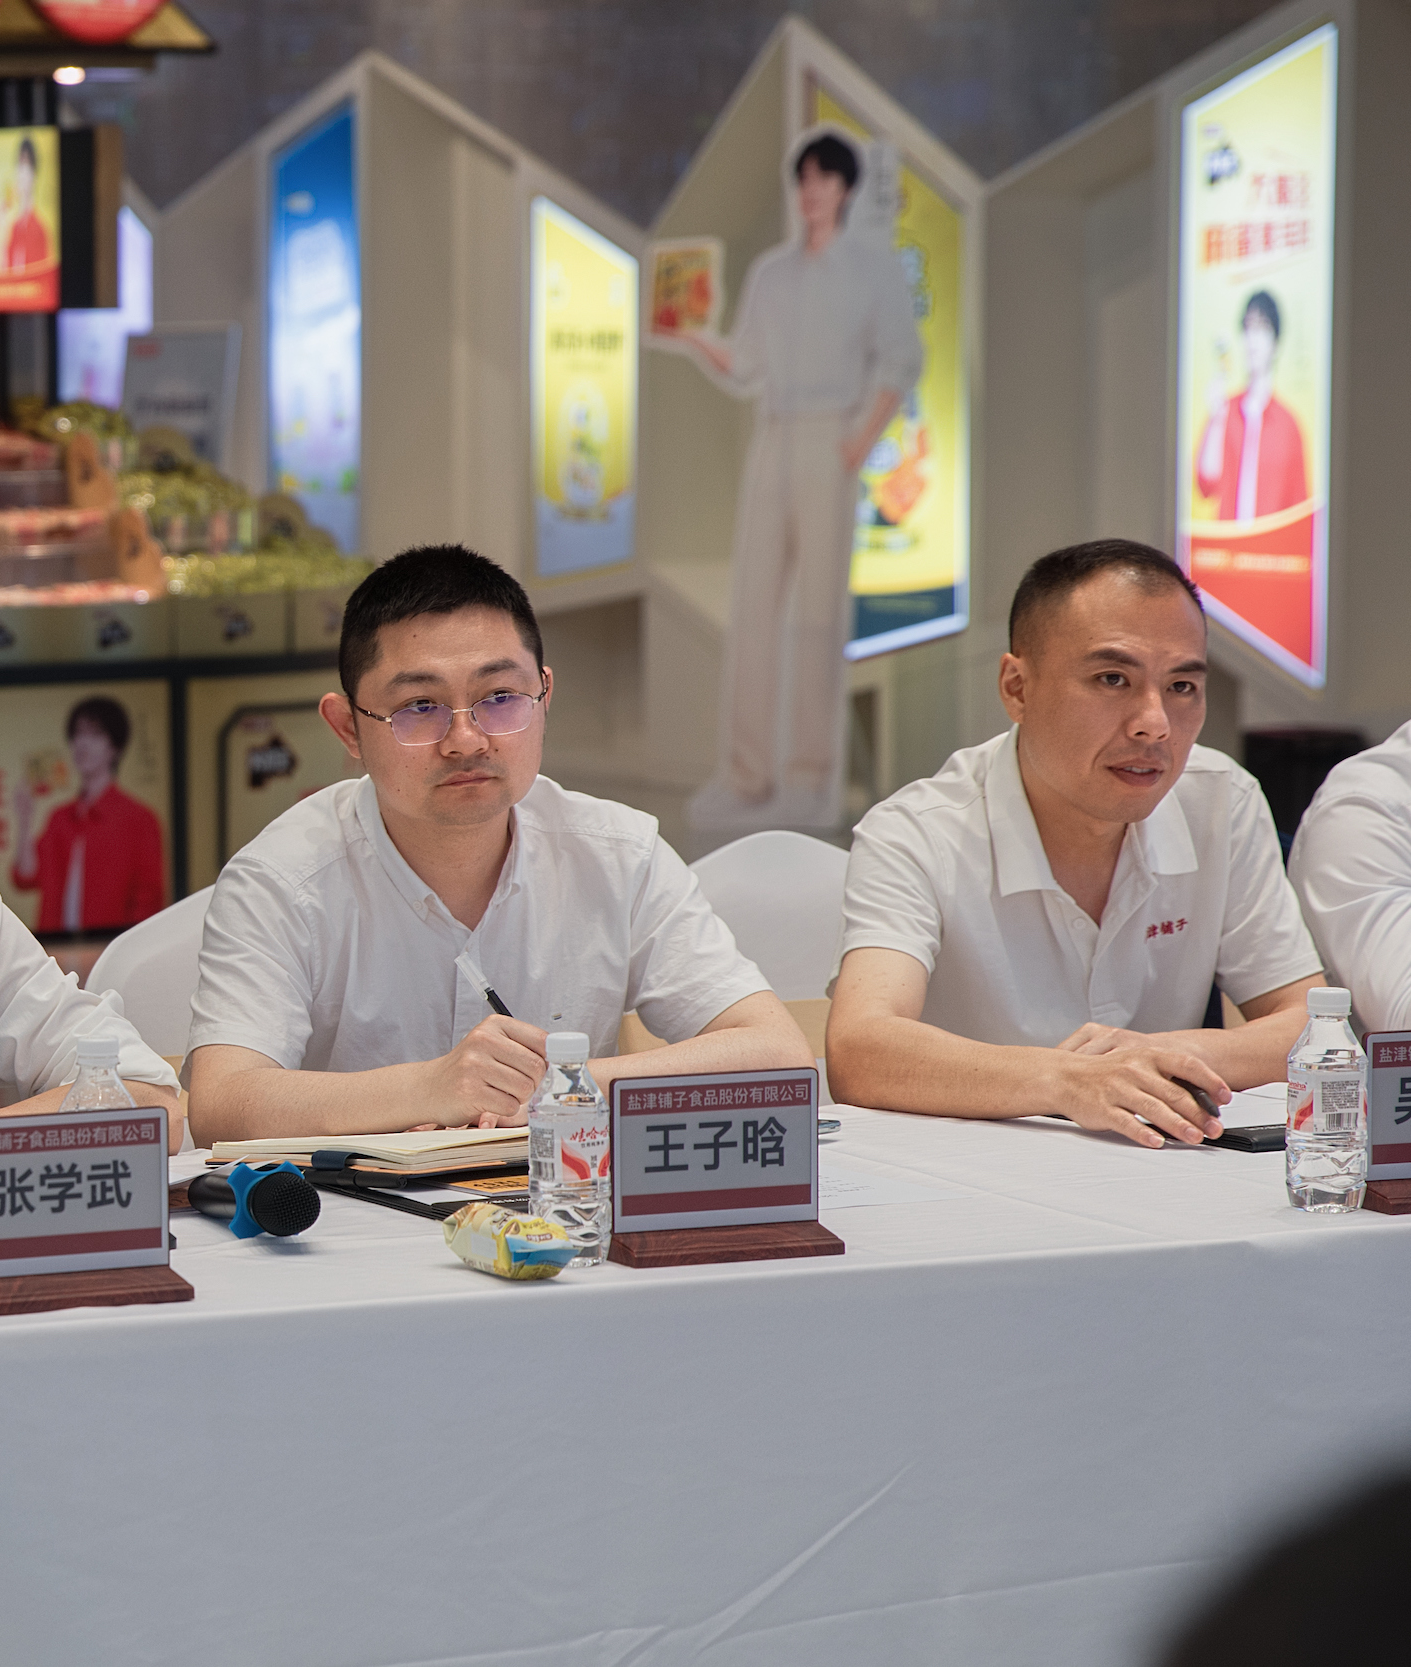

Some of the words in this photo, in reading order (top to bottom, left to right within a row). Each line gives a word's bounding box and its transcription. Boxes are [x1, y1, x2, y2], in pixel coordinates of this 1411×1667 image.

[1379, 1045, 1411, 1063] 盐津
[627, 1083, 809, 1111] 盐津铺子食品股份有限公司
[644, 1116, 787, 1173] 王子晗
